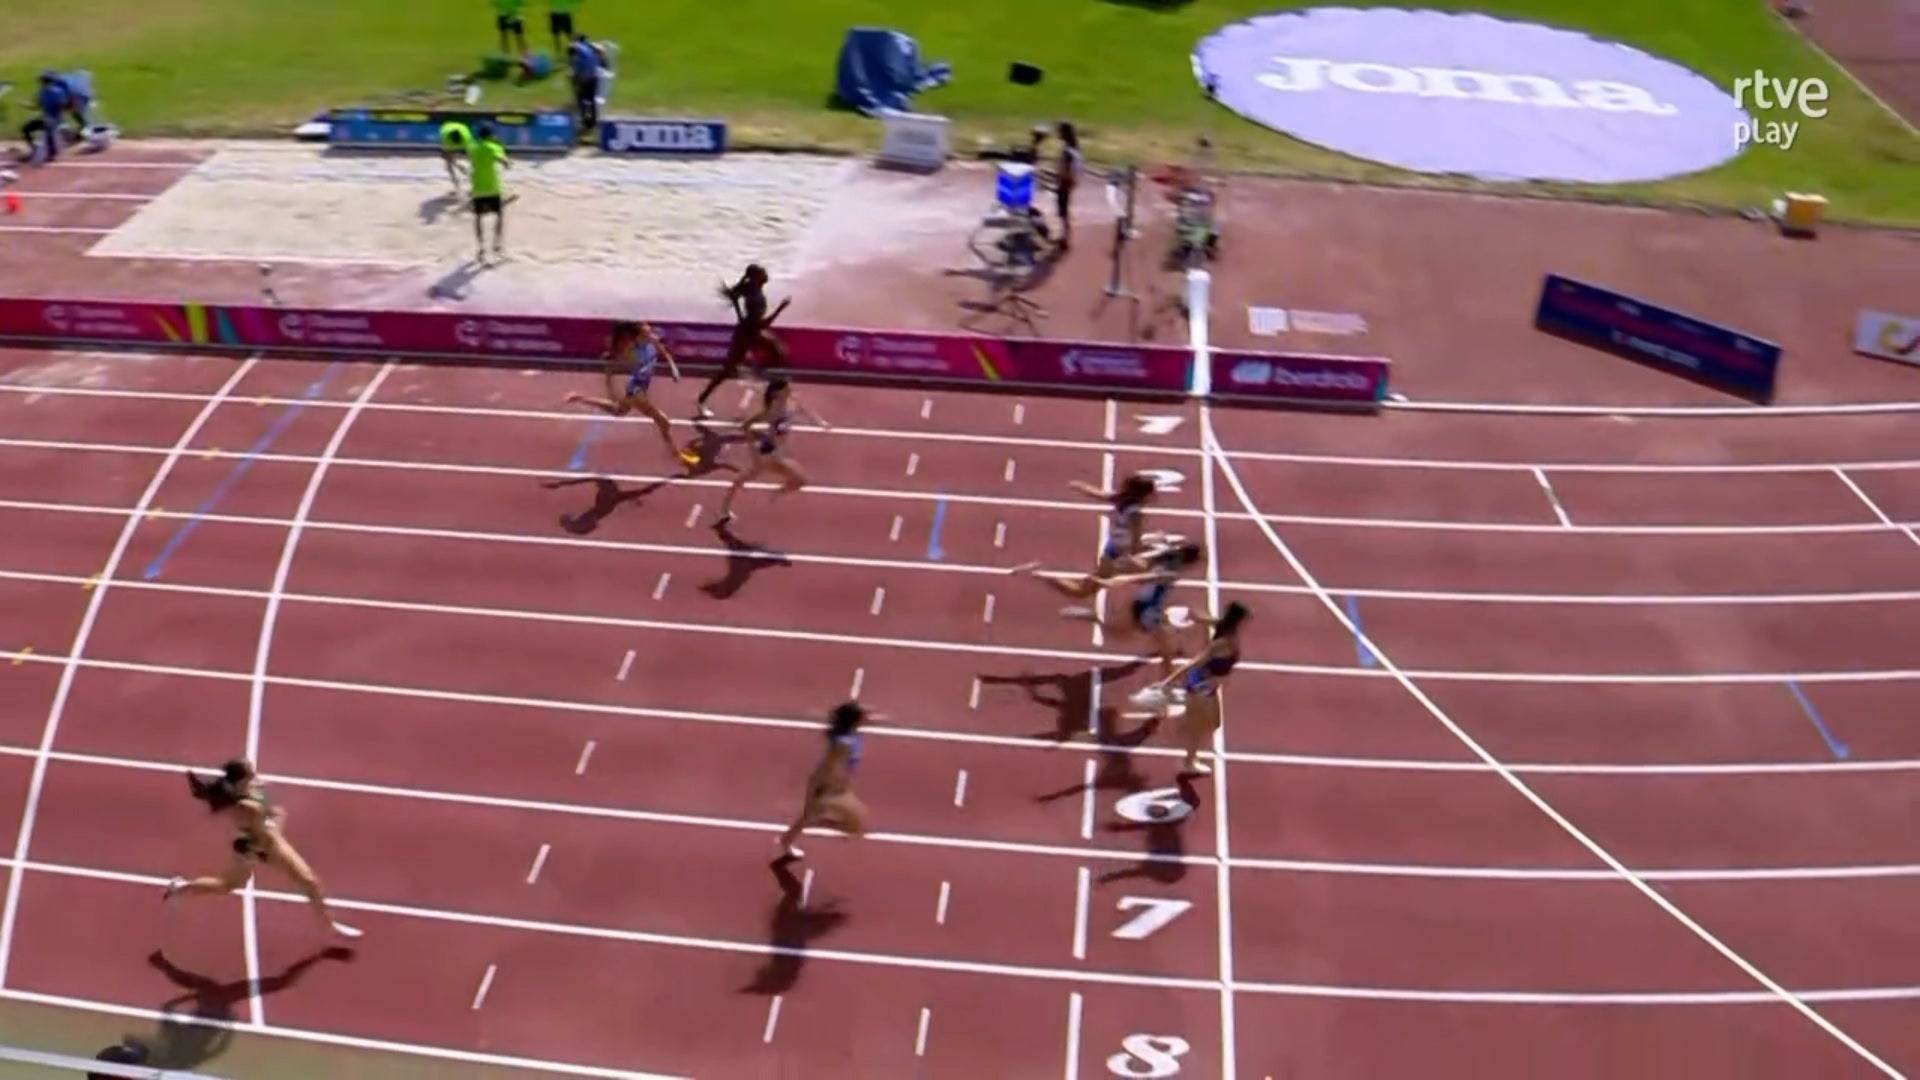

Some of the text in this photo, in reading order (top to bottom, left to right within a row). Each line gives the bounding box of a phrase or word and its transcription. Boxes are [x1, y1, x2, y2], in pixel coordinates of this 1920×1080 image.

[1256, 56, 1679, 116] Joma
[1115, 787, 1194, 822] 6
[1110, 895, 1194, 940] 7
[1105, 1033, 1191, 1079] 8
